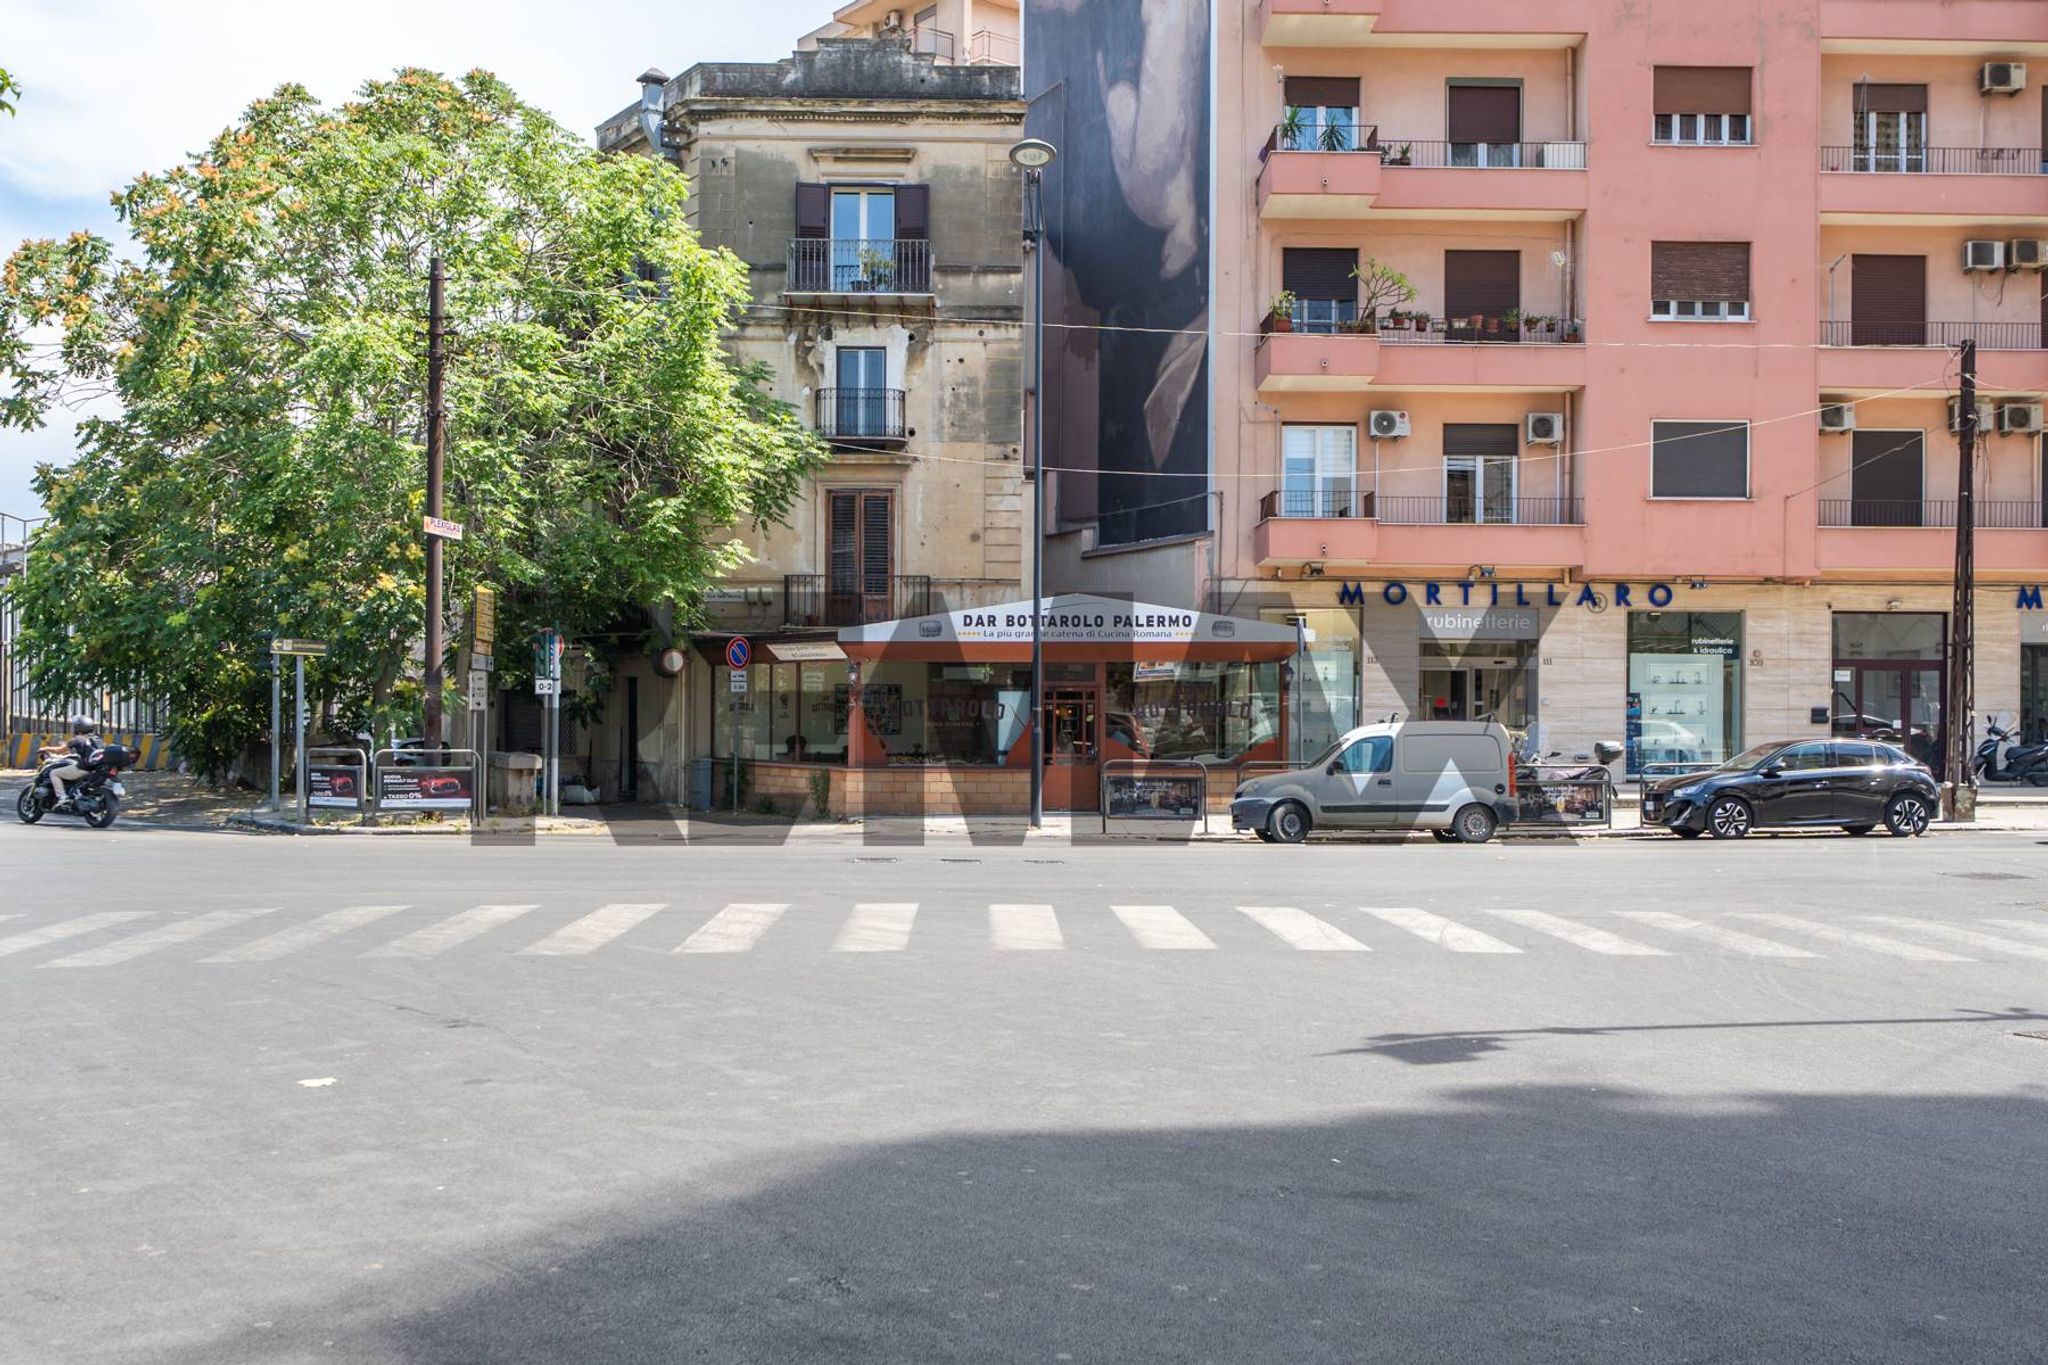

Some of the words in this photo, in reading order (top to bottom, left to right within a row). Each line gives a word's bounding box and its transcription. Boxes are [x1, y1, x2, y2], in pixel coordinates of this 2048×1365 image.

[1339, 582, 1674, 607] MORTILLARO
[963, 615, 997, 627] DAR
[1006, 615, 1104, 628] BOTTAROLO
[1113, 615, 1192, 627] PALERMO
[1426, 612, 1531, 630] rubinetterie
[997, 629, 1012, 639] più
[1052, 630, 1085, 638] catena
[1087, 629, 1096, 638] di
[1098, 629, 1130, 638] Cucina
[1134, 629, 1172, 638] Romana
